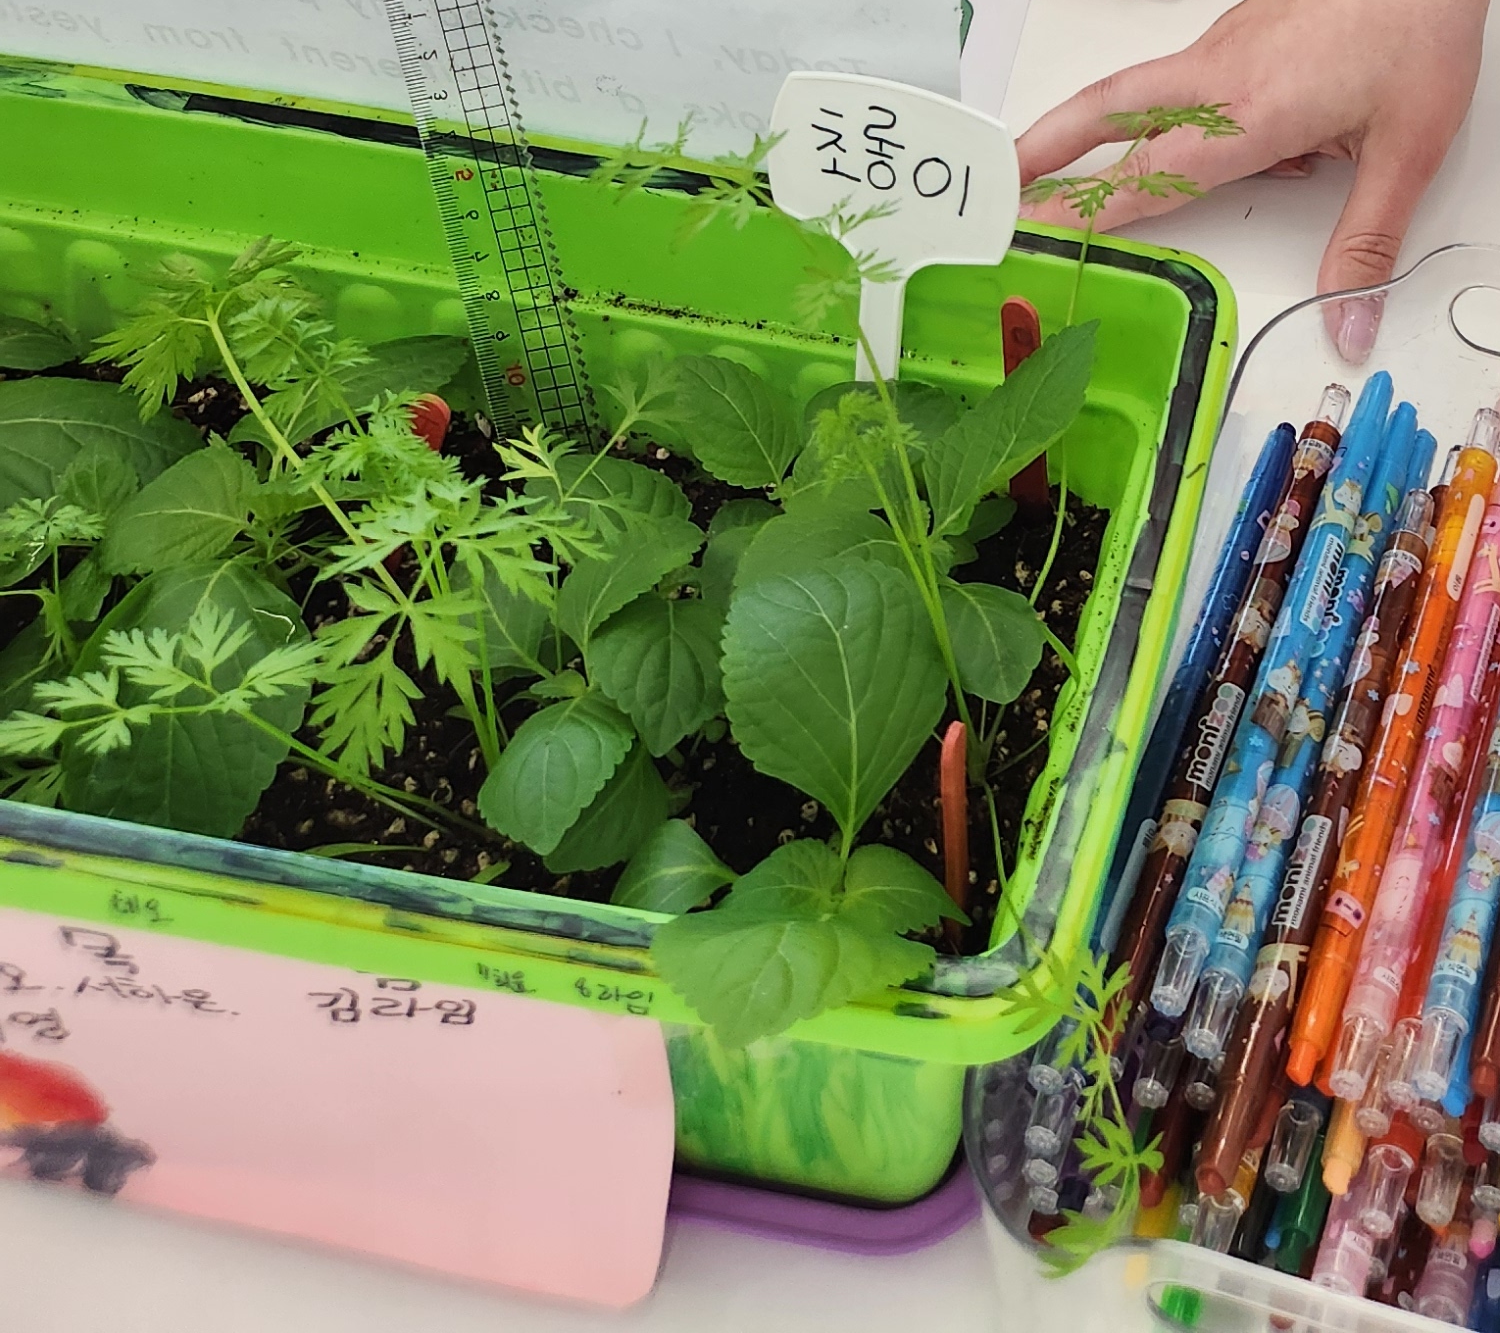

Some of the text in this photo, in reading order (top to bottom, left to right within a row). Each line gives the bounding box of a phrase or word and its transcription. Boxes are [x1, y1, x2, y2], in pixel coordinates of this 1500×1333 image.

[811, 104, 970, 218] 초롱이
[1188, 684, 1233, 783] monizoo
[1273, 817, 1318, 925] monizoo
[58, 925, 140, 976] 목
[308, 987, 478, 1026] 김라임
